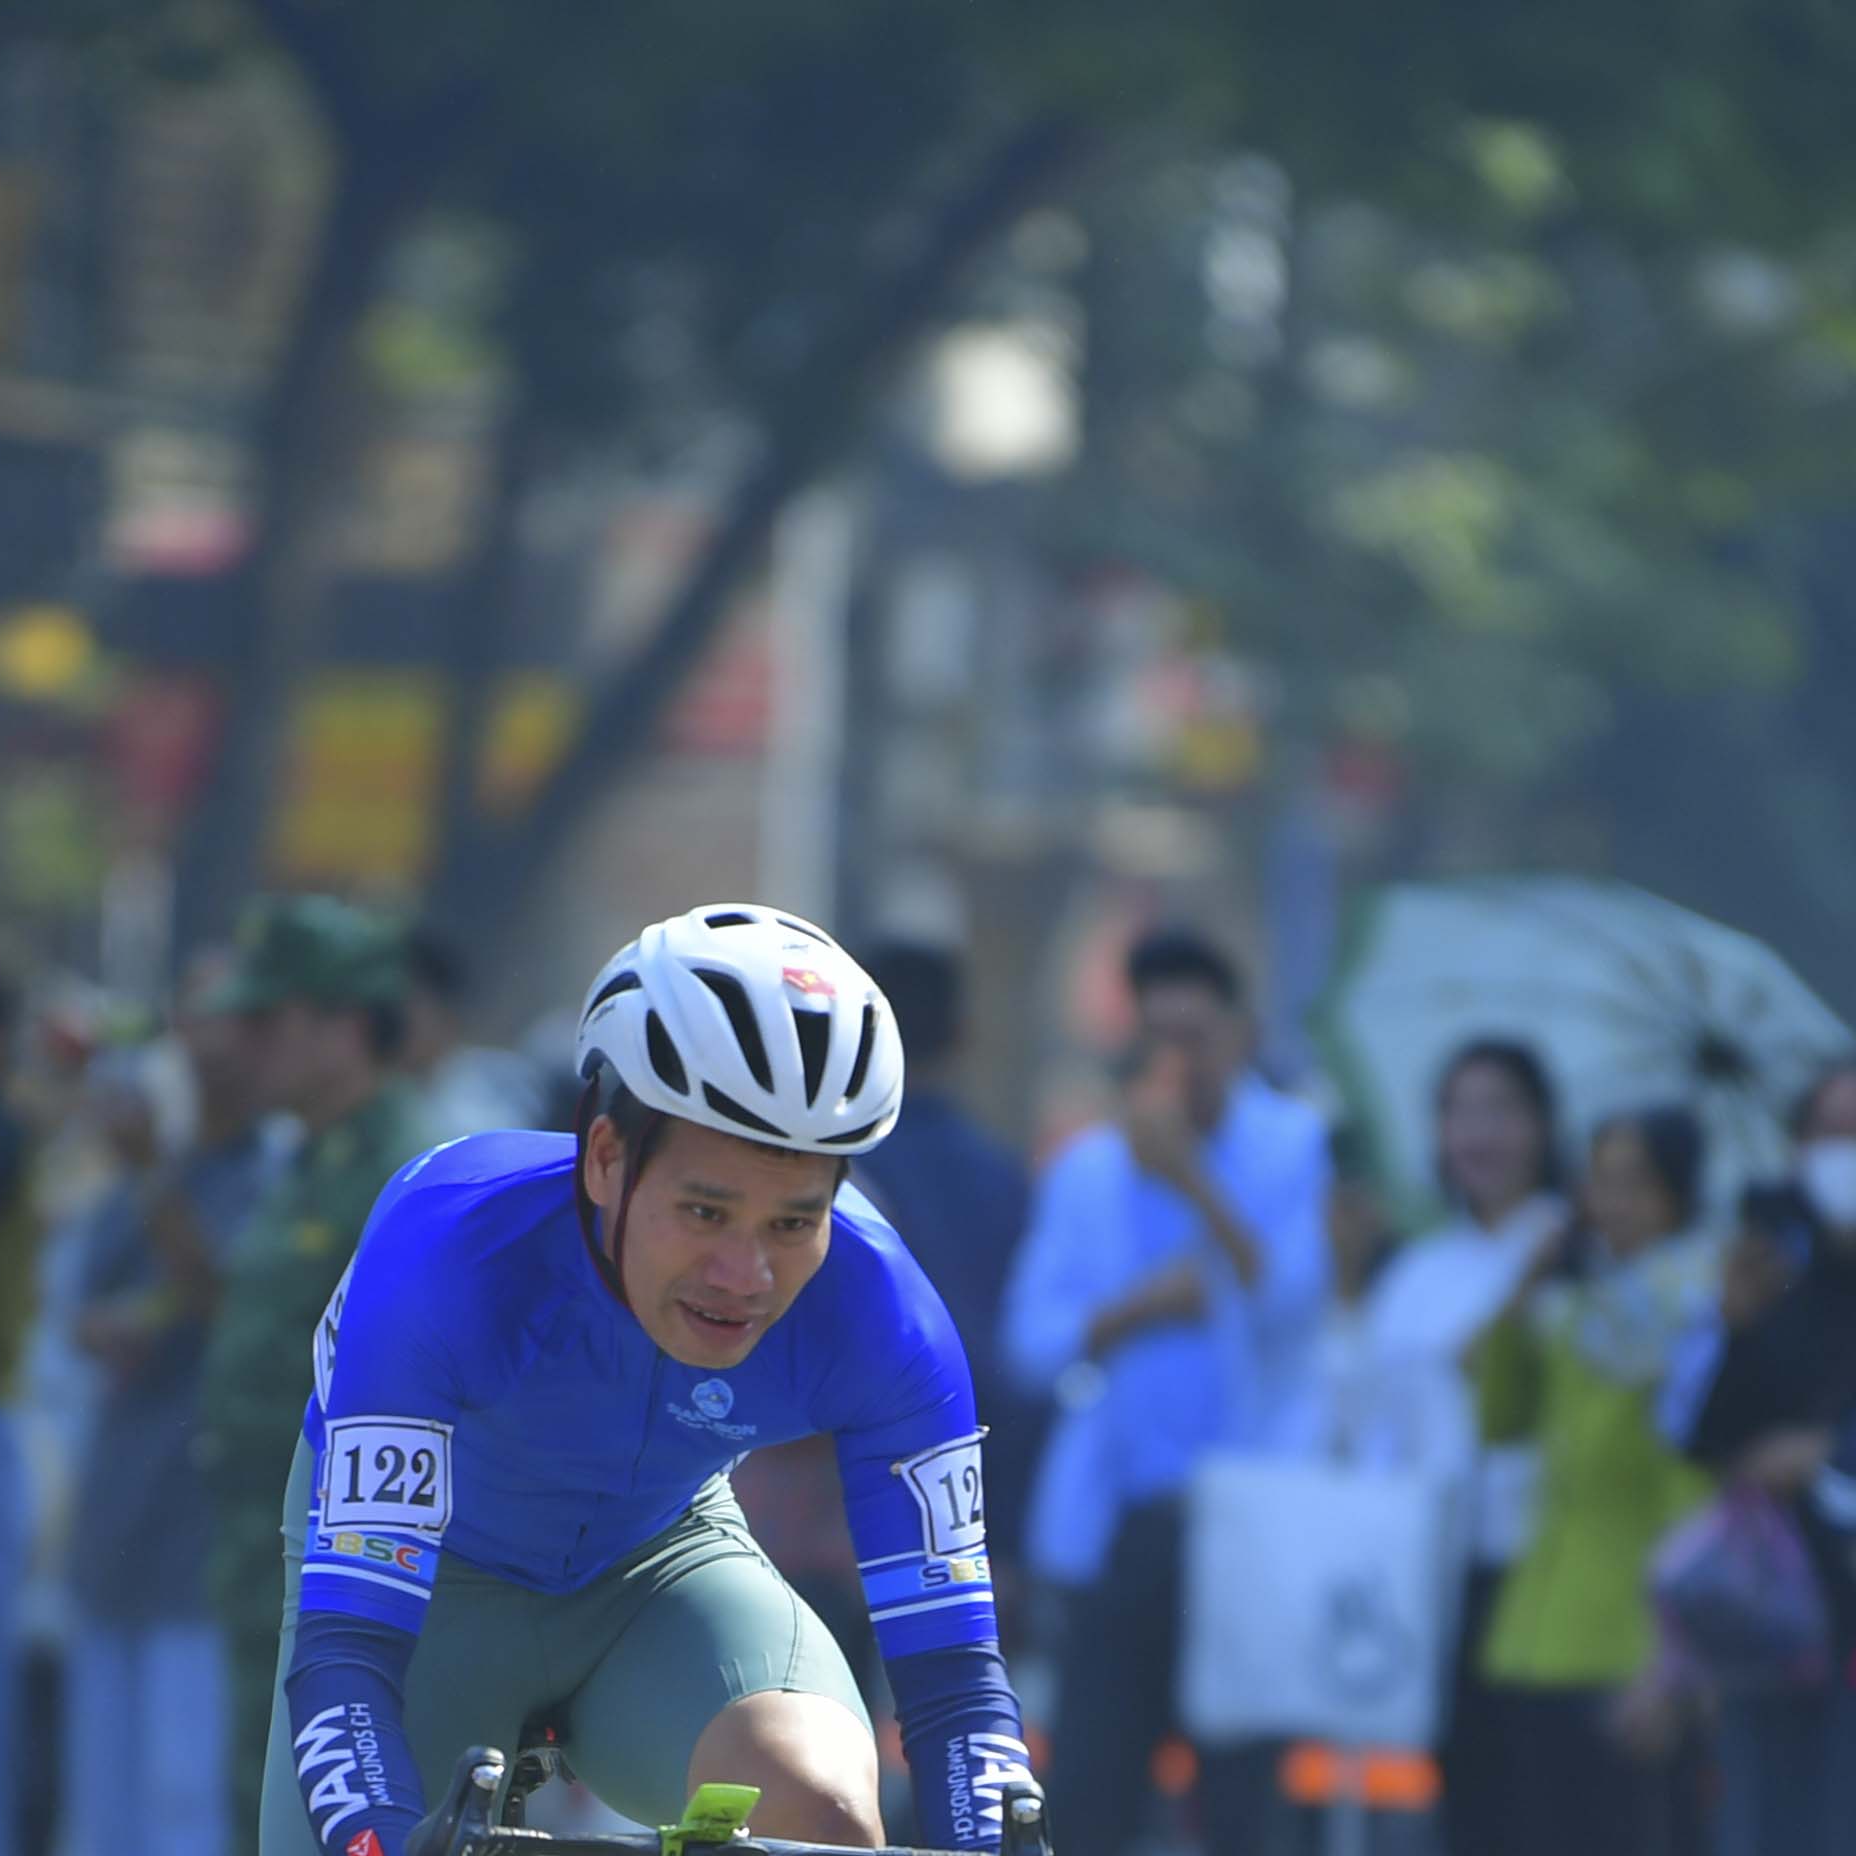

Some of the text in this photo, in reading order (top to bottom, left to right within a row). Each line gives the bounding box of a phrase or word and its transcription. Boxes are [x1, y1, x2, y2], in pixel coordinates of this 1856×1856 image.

[341, 1444, 437, 1508] 122
[316, 1532, 421, 1573] SBSC
[294, 1703, 371, 1846] IAM
